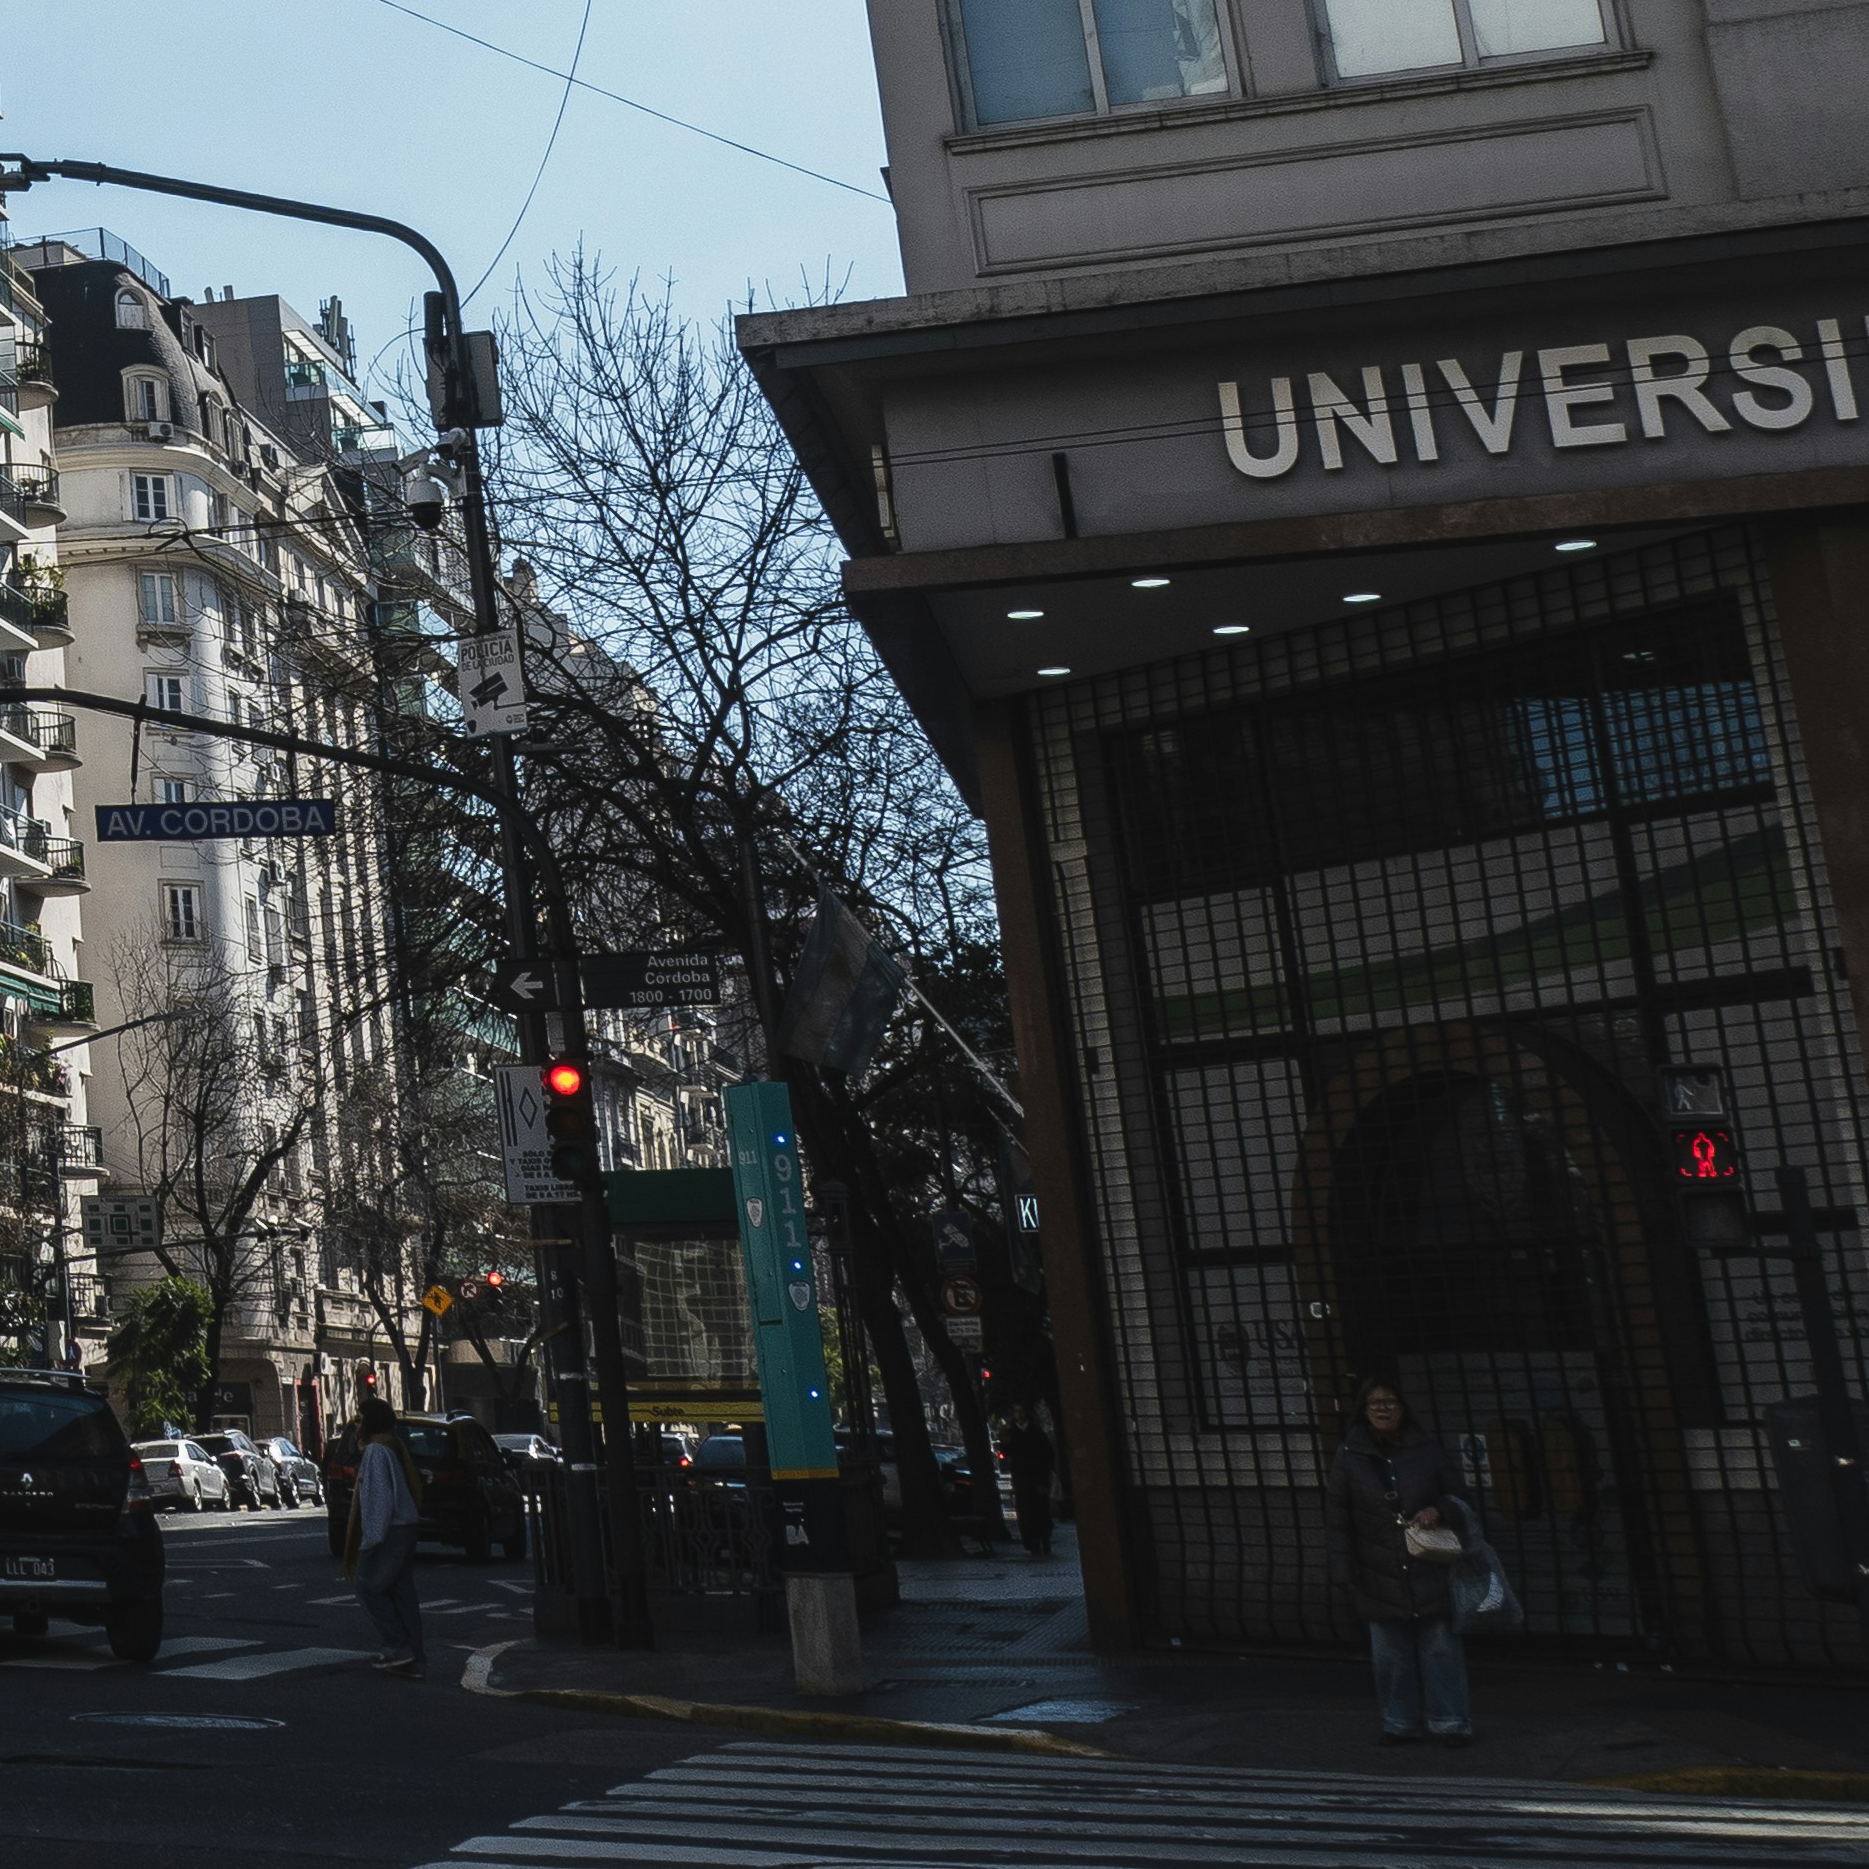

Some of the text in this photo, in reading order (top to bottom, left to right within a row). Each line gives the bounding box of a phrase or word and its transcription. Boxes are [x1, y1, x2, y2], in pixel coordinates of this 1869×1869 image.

[1217, 314, 1869, 480] UNIVERSI
[107, 806, 326, 836] AV. CORDOBA
[647, 953, 709, 968] Avenida
[629, 989, 663, 1004] 1800
[679, 988, 712, 1002] 1700
[738, 1150, 759, 1165] 911
[773, 1154, 802, 1248] 911
[551, 1286, 564, 1300] 10
[652, 1405, 685, 1417] Subte
